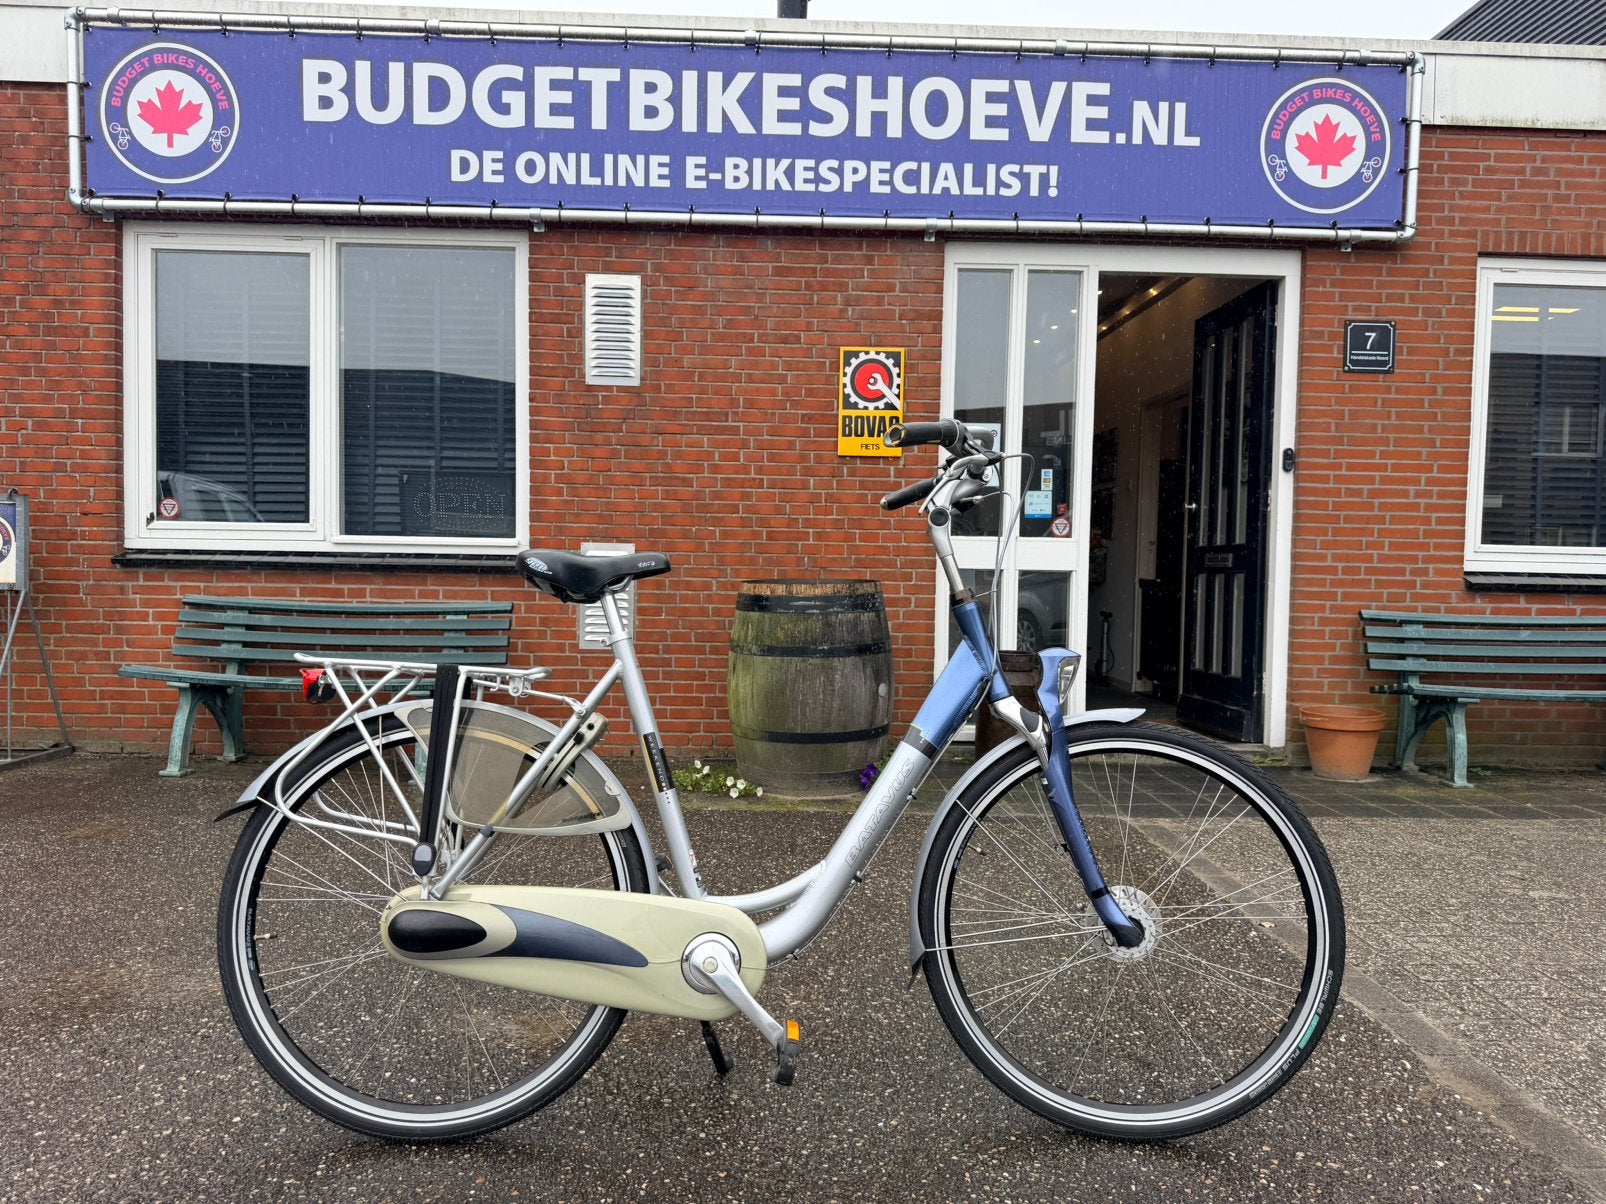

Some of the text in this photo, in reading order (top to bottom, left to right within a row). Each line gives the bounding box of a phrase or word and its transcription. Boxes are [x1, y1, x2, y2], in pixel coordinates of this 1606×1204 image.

[111, 53, 229, 110] BUDGET BIKES HOEVE
[302, 58, 1201, 147] BUDGETBIKESHOEVE.NL
[1271, 88, 1381, 142] BUDGET BIKES HOEVE
[450, 149, 1059, 198] DE ONLINE E-BIKESPECIALIST!
[1364, 332, 1376, 350] 7
[860, 443, 880, 451] FIETS
[413, 492, 505, 519] OPEN
[845, 758, 915, 867] BATAVUS
[1317, 969, 1334, 1015] SCHWALBE
